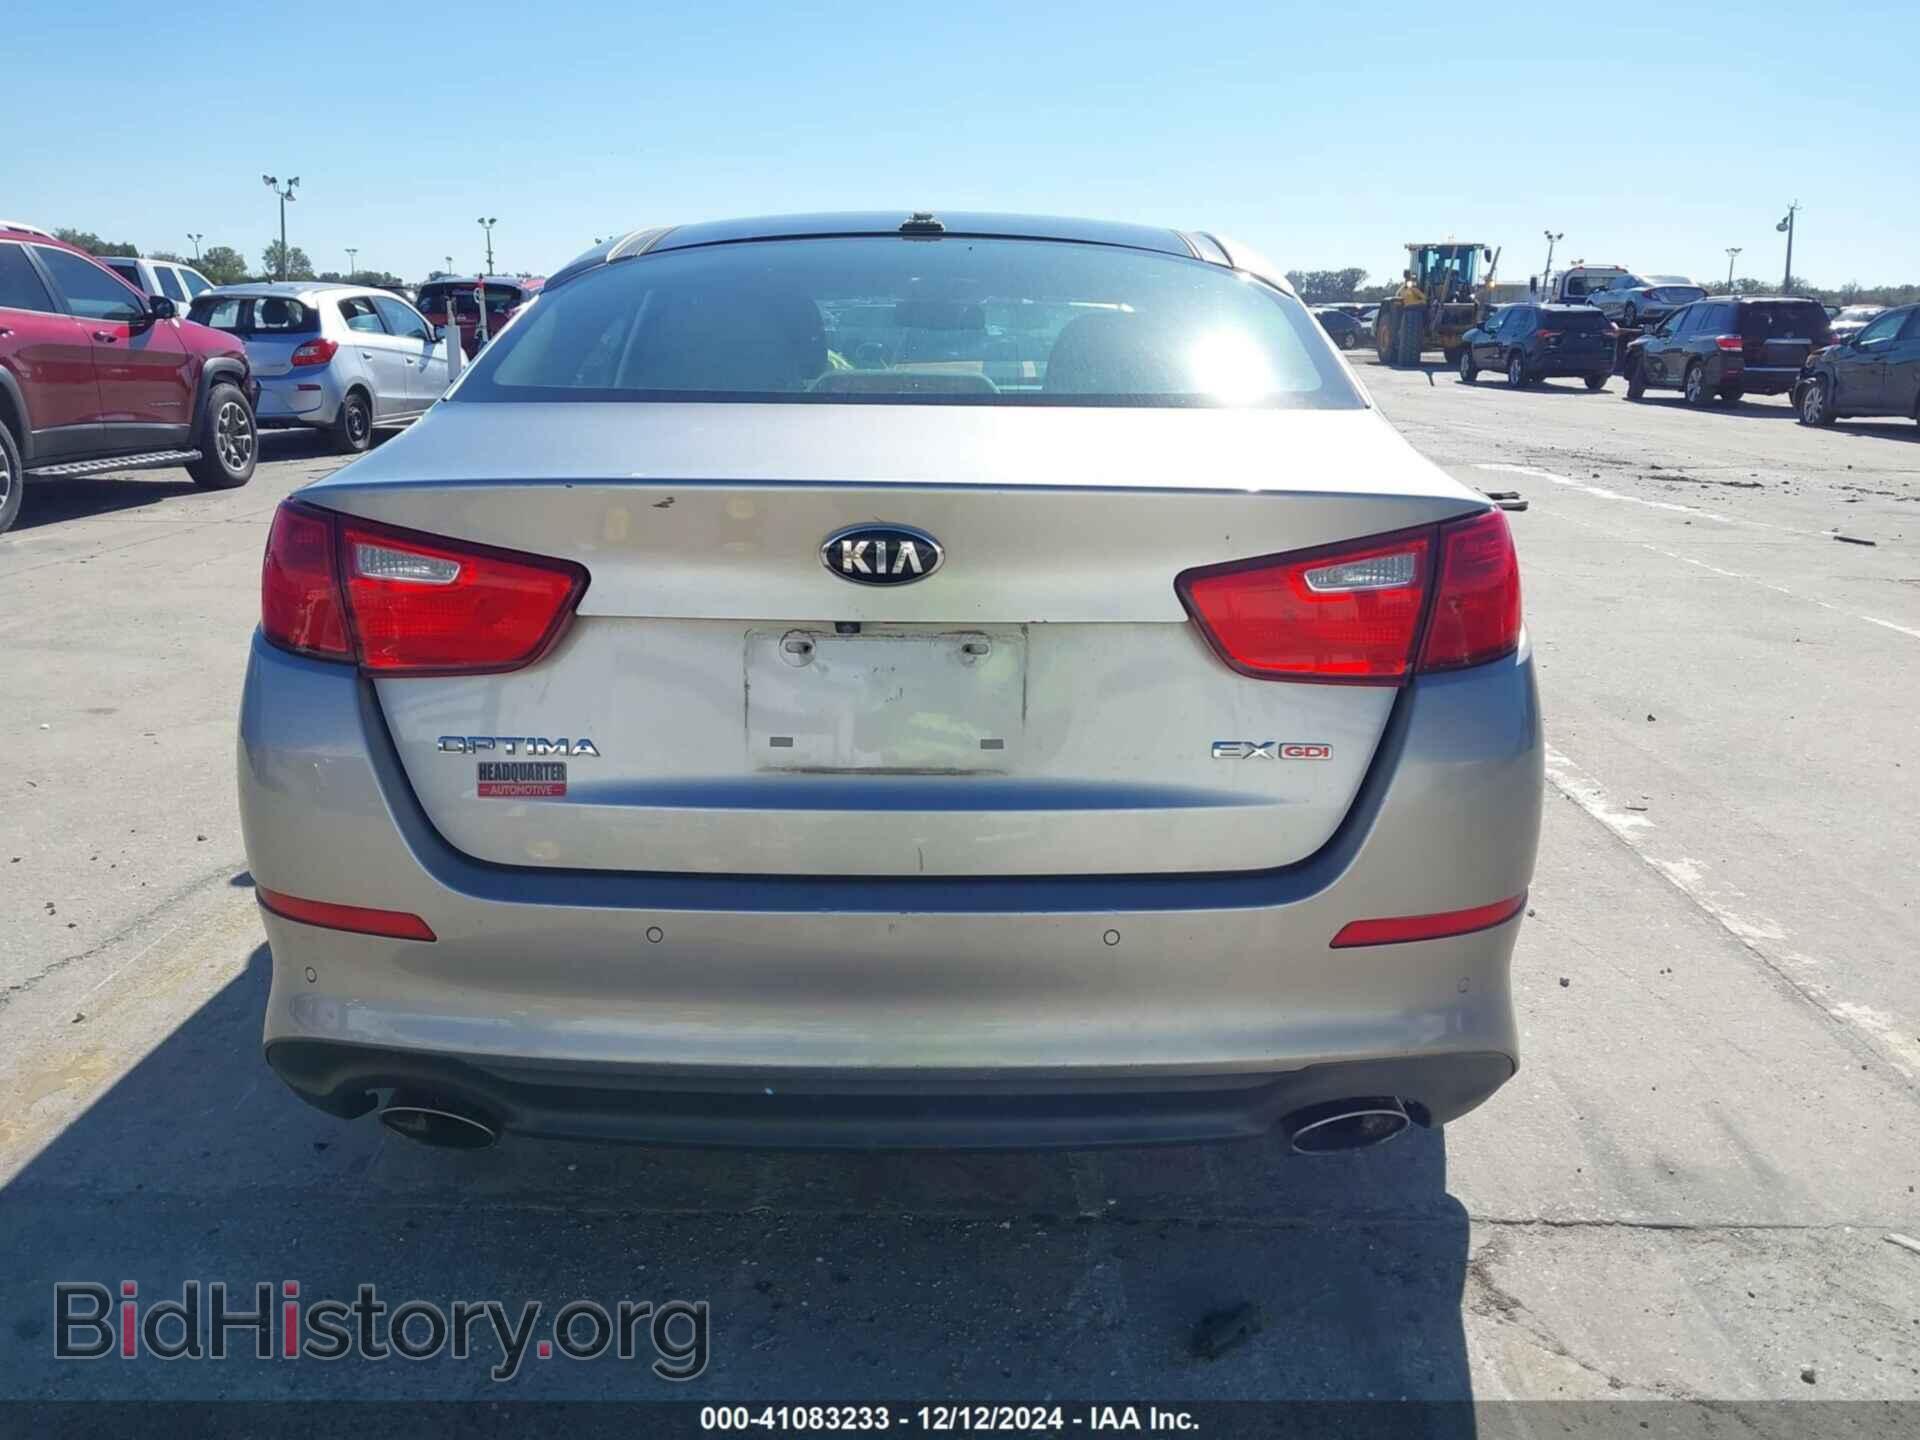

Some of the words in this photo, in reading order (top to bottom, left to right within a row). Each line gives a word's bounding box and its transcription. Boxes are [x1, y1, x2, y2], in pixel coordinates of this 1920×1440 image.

[841, 540, 923, 574] KIA
[437, 736, 600, 757] OPTIMA
[1212, 741, 1275, 760] EX
[1284, 746, 1329, 758] GDI
[478, 762, 565, 782] HEADQUARTER
[489, 784, 553, 796] AUTOMOTIVE
